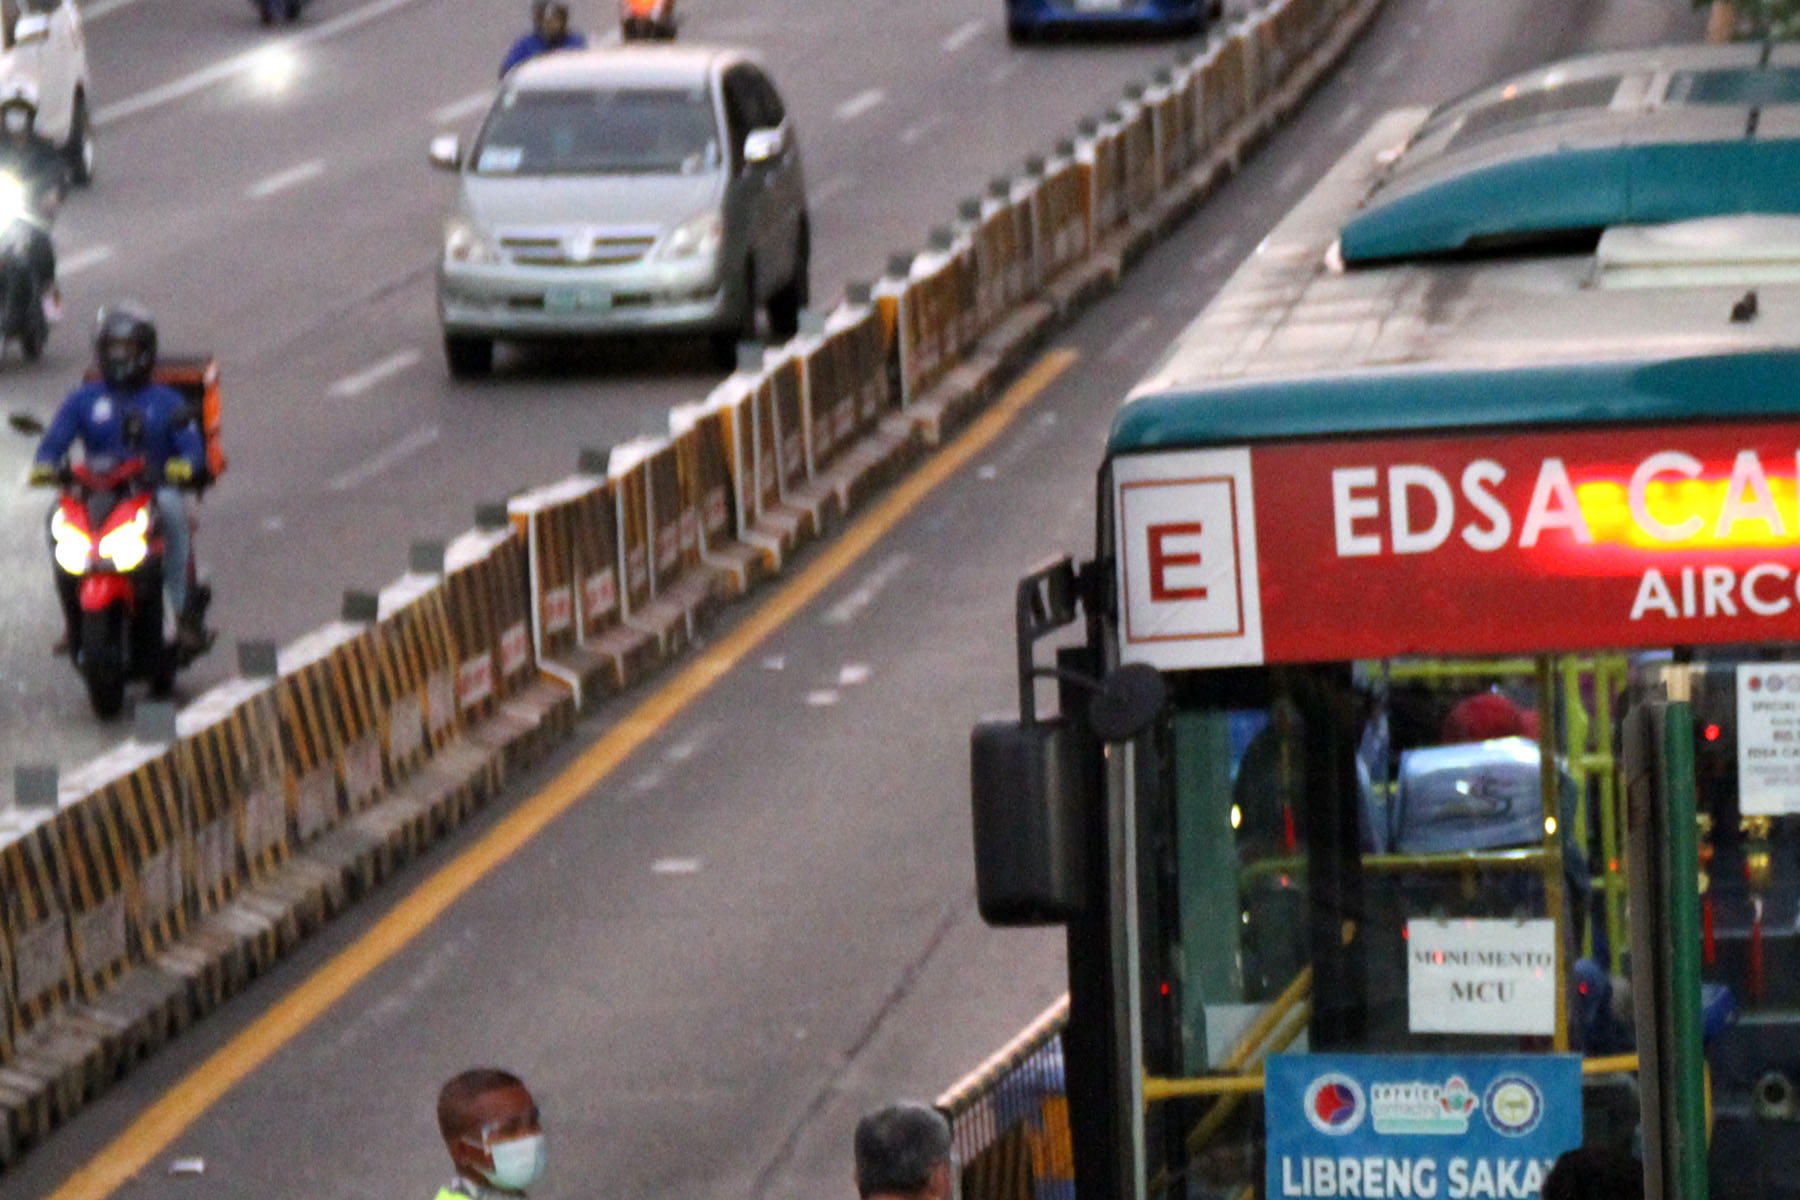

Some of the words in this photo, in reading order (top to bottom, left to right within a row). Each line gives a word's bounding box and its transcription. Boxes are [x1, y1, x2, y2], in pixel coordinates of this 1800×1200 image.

[1333, 457, 1591, 558] EDSA
[1147, 521, 1208, 603] E
[1414, 950, 1552, 966] MONUMENTO
[1450, 980, 1514, 1003] MCU
[1281, 1156, 1438, 1199] LIBRENG
